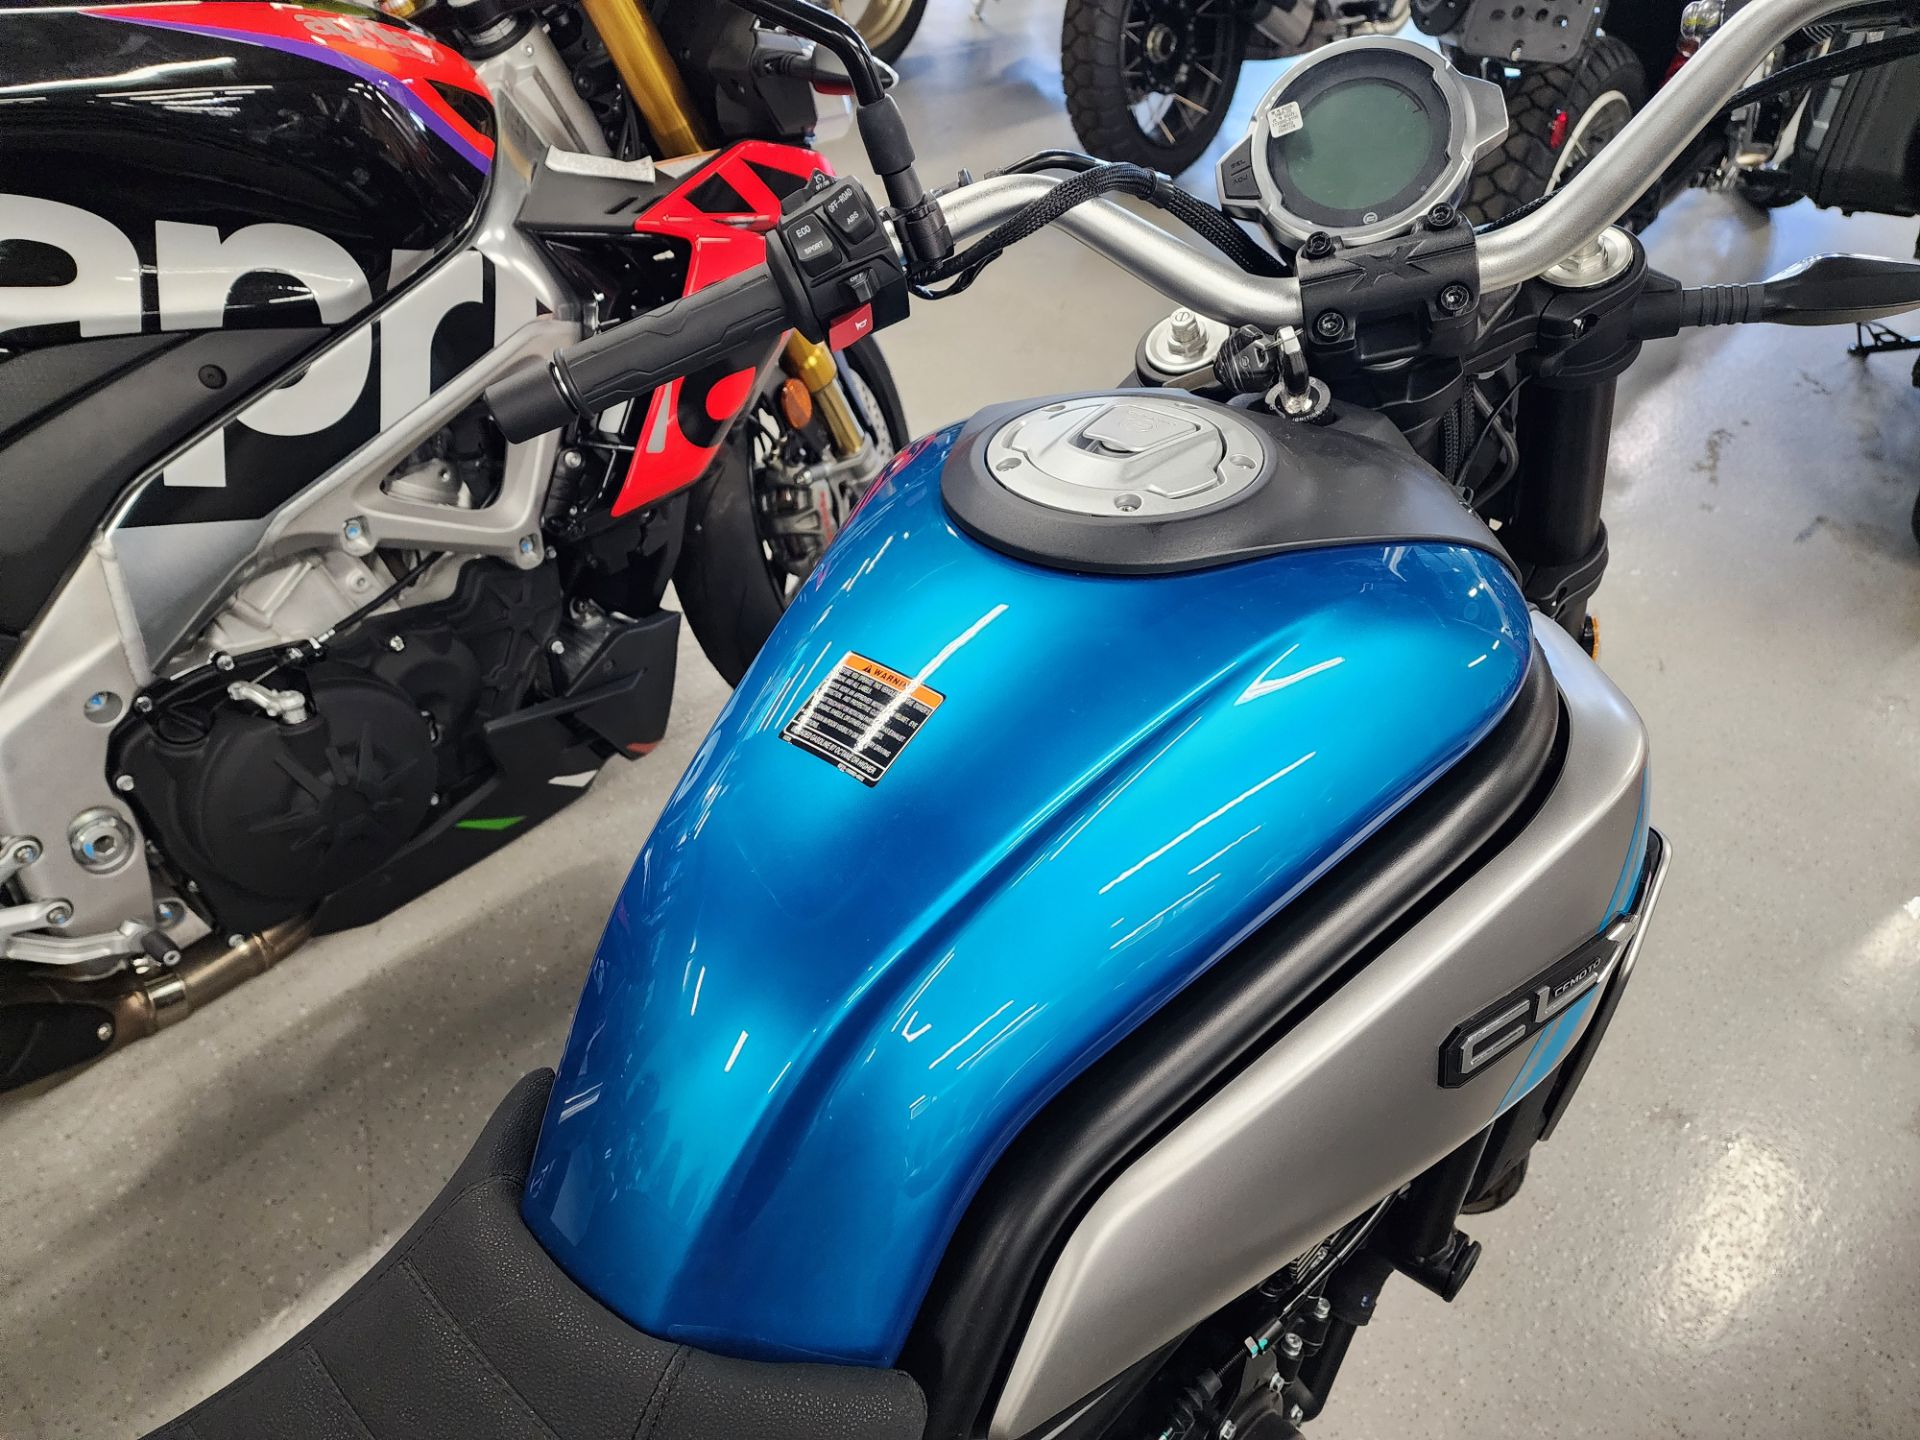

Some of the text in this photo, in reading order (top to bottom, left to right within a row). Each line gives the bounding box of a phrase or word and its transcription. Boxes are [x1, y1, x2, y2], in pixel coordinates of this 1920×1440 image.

[827, 187, 853, 213] OFF-ROAD
[846, 210, 860, 225] ABS
[795, 225, 811, 238] ECO
[804, 240, 824, 255] SPORT
[1553, 957, 1601, 998] CFMOTO
